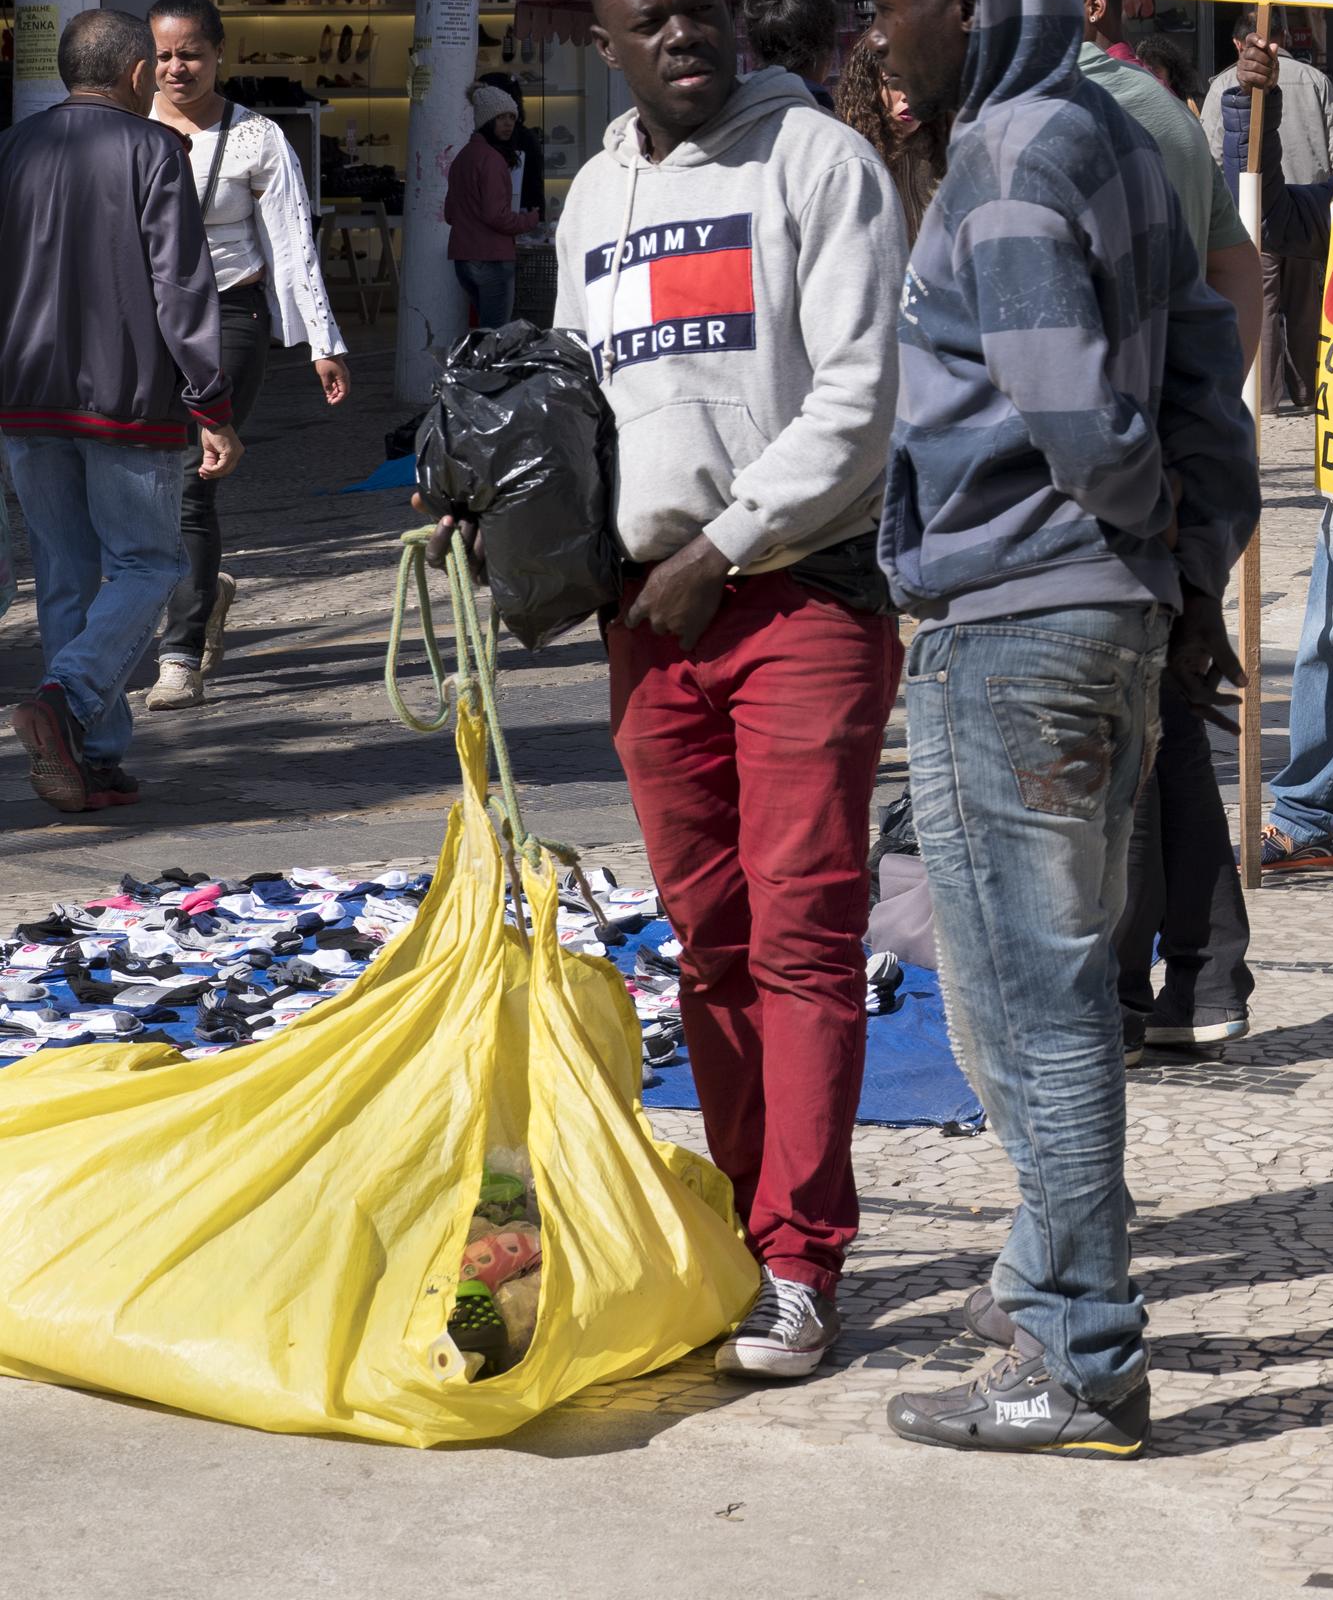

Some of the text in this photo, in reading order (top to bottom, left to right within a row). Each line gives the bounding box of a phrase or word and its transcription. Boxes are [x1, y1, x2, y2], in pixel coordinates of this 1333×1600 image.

[602, 224, 714, 269] TOMMY
[616, 320, 726, 361] LFIGER
[1315, 382, 1329, 421] A
[995, 1392, 1051, 1425] EVERLAST
